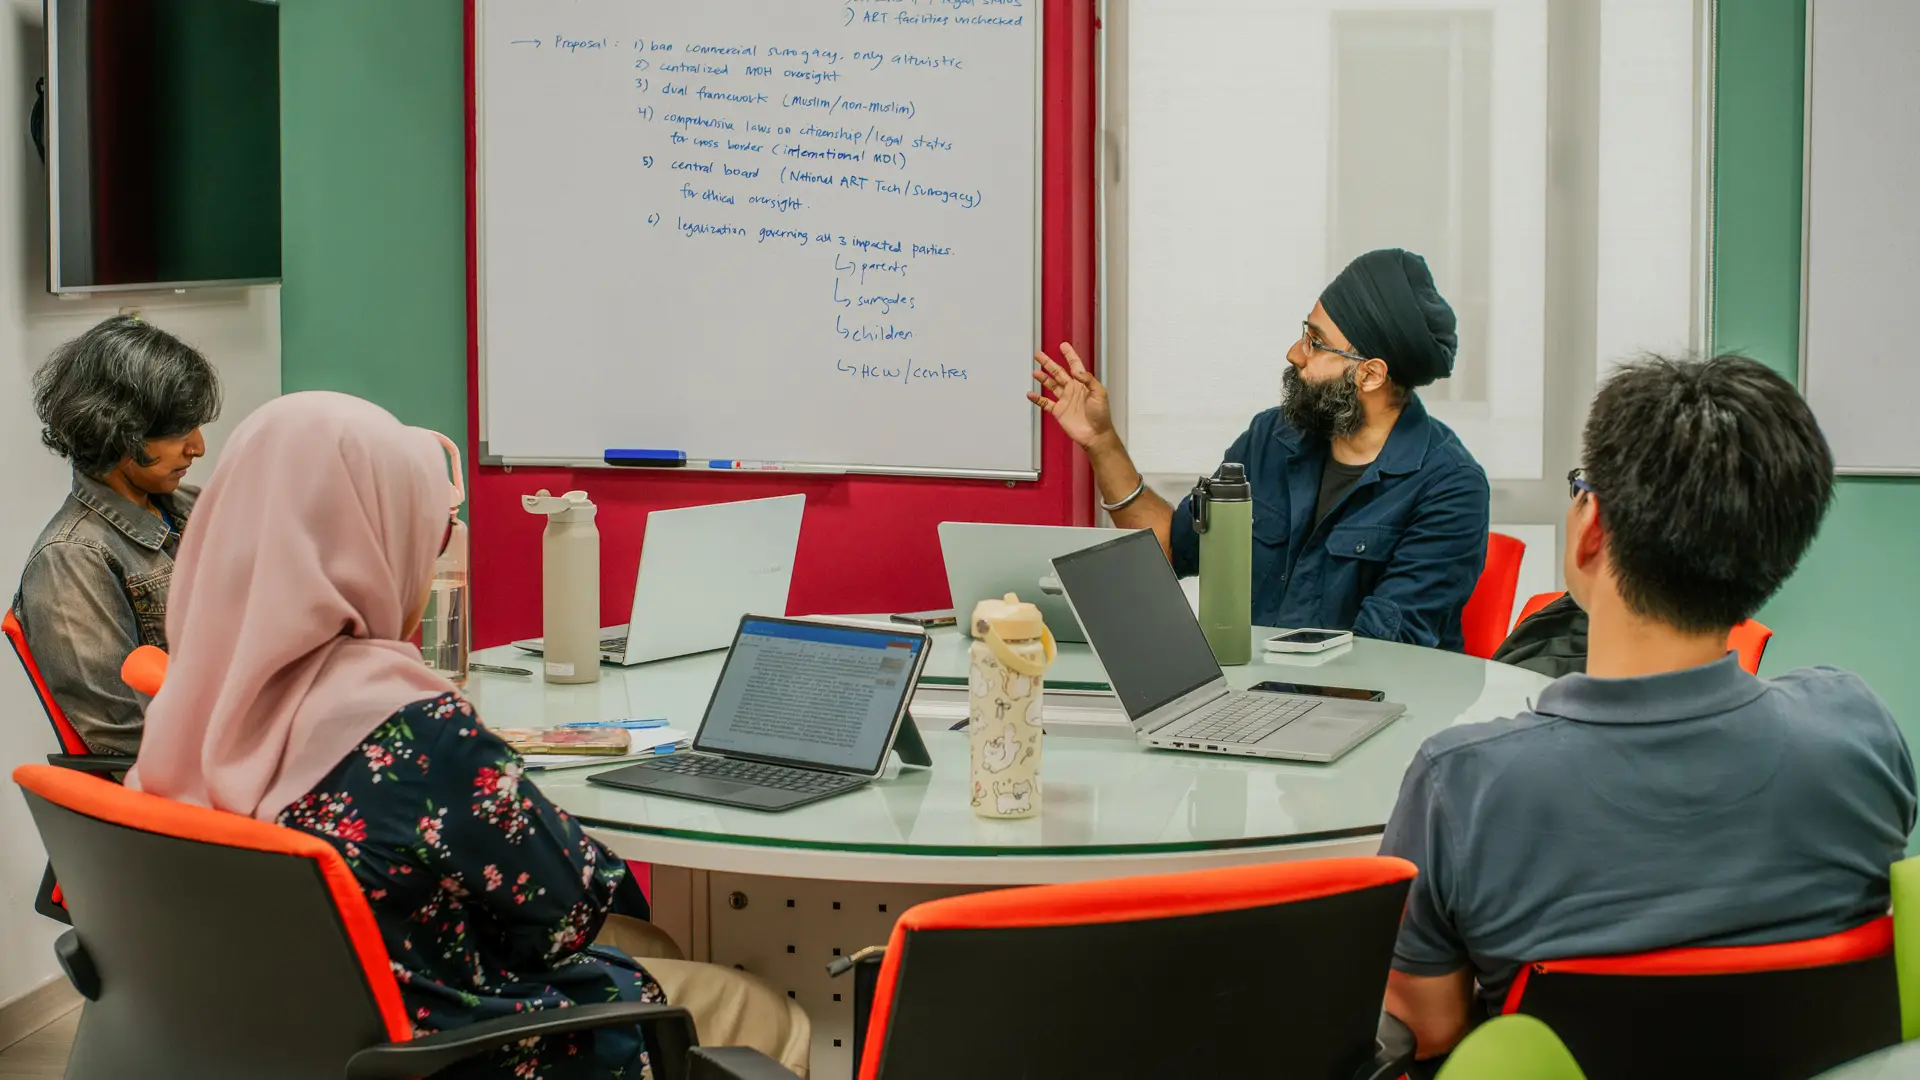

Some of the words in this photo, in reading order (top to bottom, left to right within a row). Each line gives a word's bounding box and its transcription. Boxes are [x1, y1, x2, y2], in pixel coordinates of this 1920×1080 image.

[862, 10, 889, 24] ART
[893, 10, 949, 26] facilities
[954, 14, 1023, 26] unchecked
[555, 34, 607, 54] Proposal
[633, 38, 644, 53] 1)
[650, 40, 673, 52] ban
[685, 43, 757, 57] commercial
[853, 50, 884, 71] only
[635, 58, 650, 72] 2)
[659, 61, 729, 76] centralized
[745, 65, 773, 77] MOH
[783, 69, 841, 86] oversight
[635, 77, 649, 93] 3)
[661, 81, 688, 97] dual
[695, 85, 769, 104] framework
[638, 105, 654, 123] 4)
[745, 120, 772, 134] laws
[777, 126, 792, 135] on
[911, 134, 953, 151] status
[669, 131, 689, 145] for
[693, 137, 720, 149] cross
[727, 139, 764, 153] border
[642, 155, 654, 169] 5)
[670, 160, 714, 174] central
[723, 163, 760, 179] board
[839, 175, 869, 190] ART
[679, 182, 699, 199] for
[701, 188, 735, 205] ethical
[757, 227, 809, 247] governing
[837, 235, 847, 246] 3
[852, 235, 902, 253] impacted
[860, 260, 908, 286] parents
[852, 324, 913, 342] children
